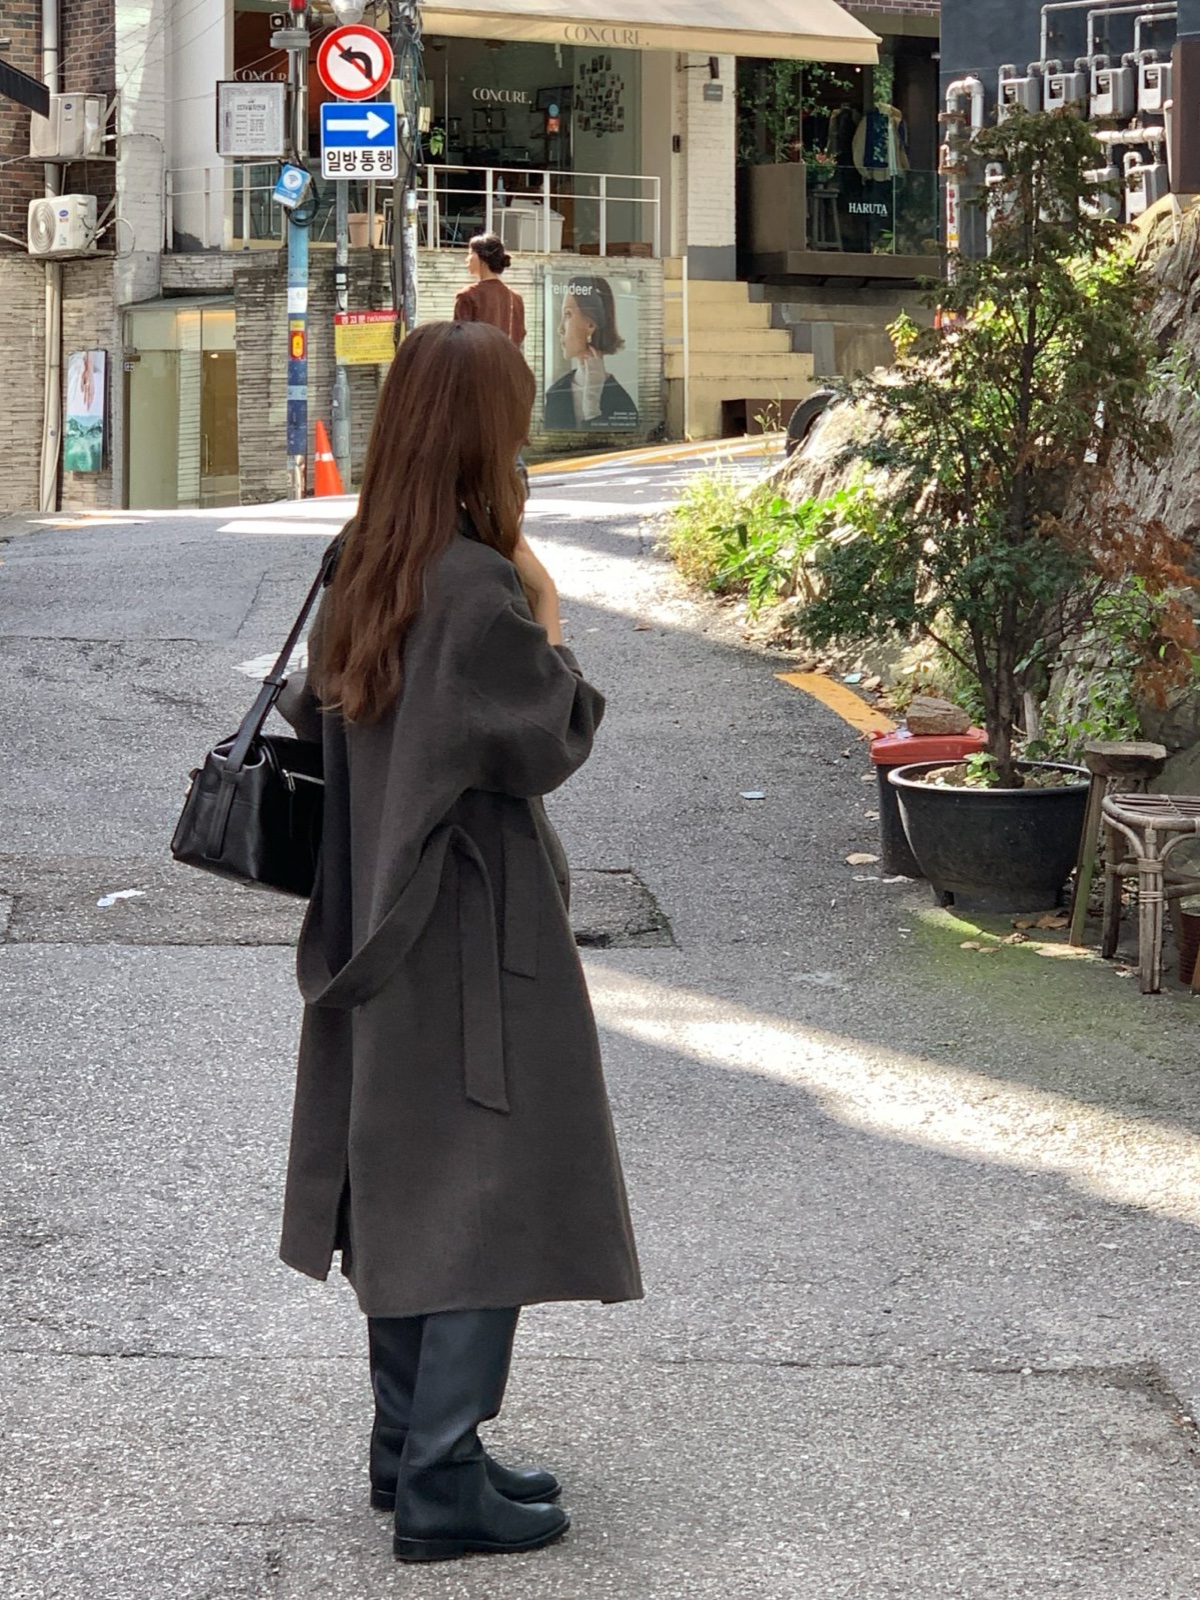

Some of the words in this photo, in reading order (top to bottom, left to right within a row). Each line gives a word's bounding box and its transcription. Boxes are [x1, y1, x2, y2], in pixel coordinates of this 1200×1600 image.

[472, 87, 532, 104] CONCURE.
[326, 149, 393, 172] 일방통행
[848, 202, 888, 215] HARUTA
